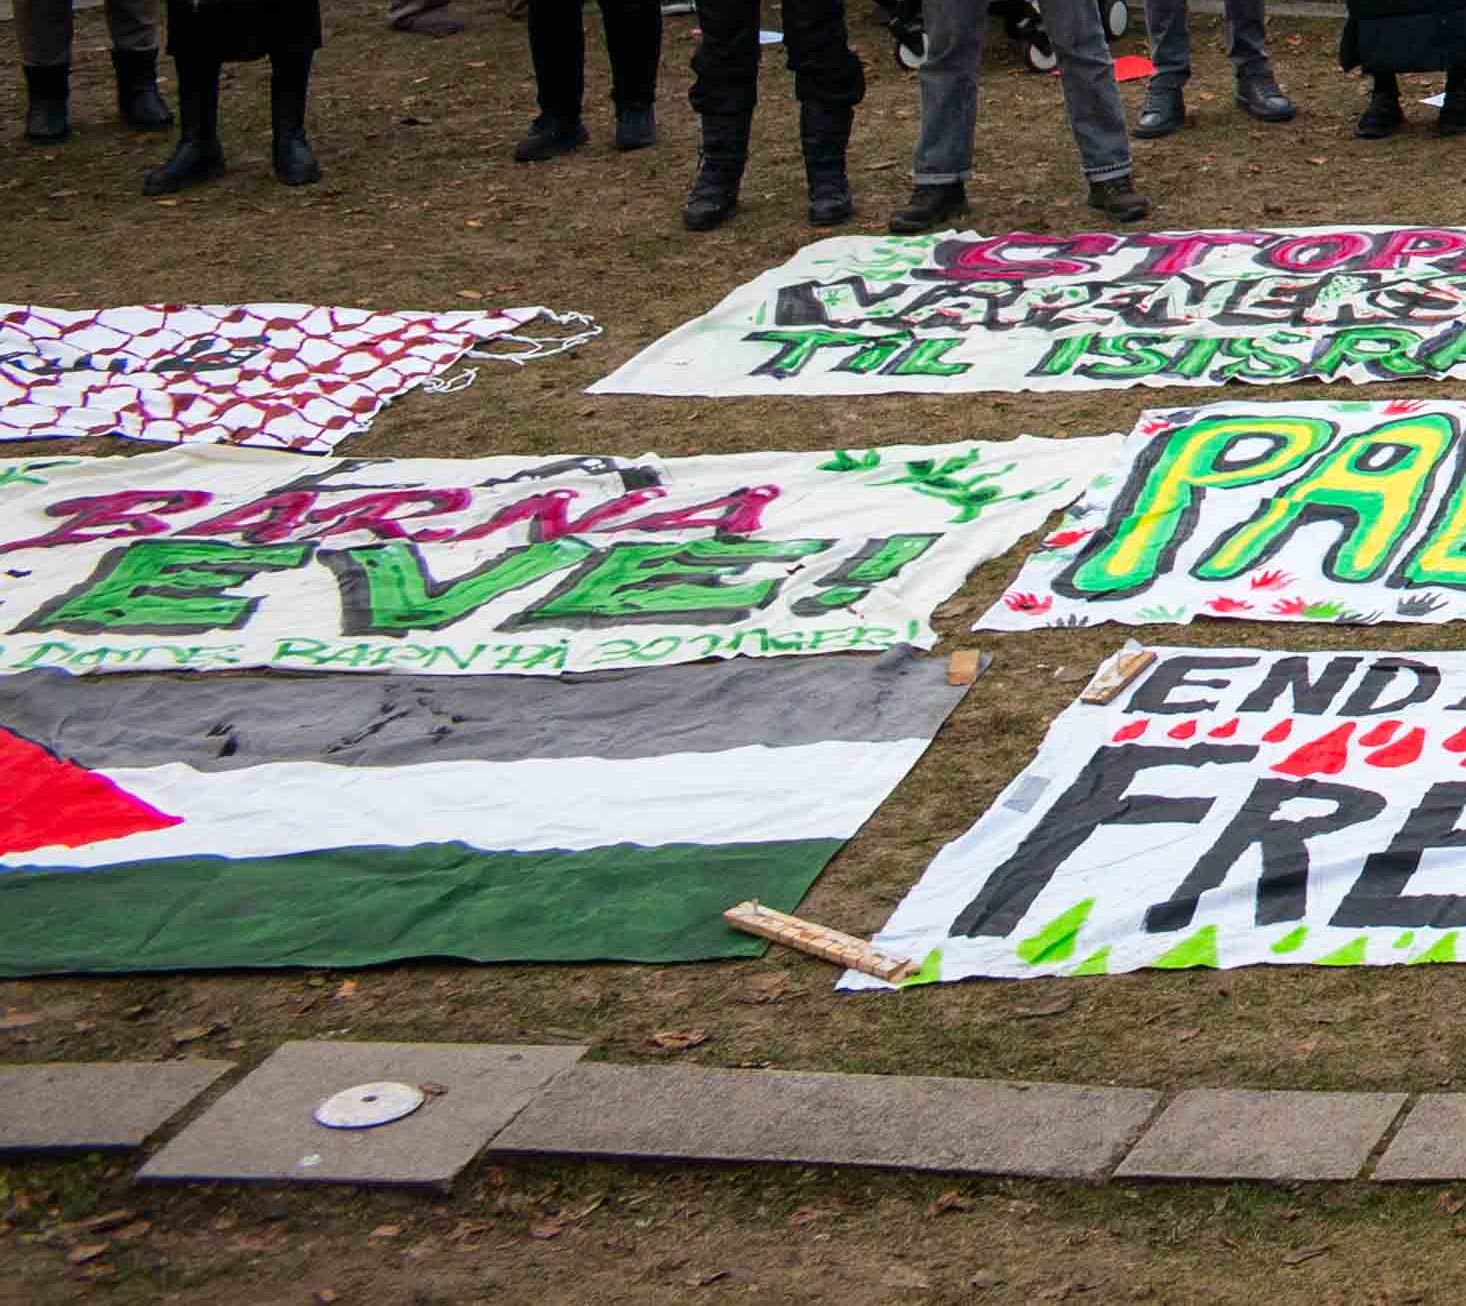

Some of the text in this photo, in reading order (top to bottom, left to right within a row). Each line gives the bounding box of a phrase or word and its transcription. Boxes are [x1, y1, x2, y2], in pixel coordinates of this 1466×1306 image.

[748, 330, 978, 379] TIL
[0, 483, 783, 550] BARNA
[1122, 654, 1442, 717] END
